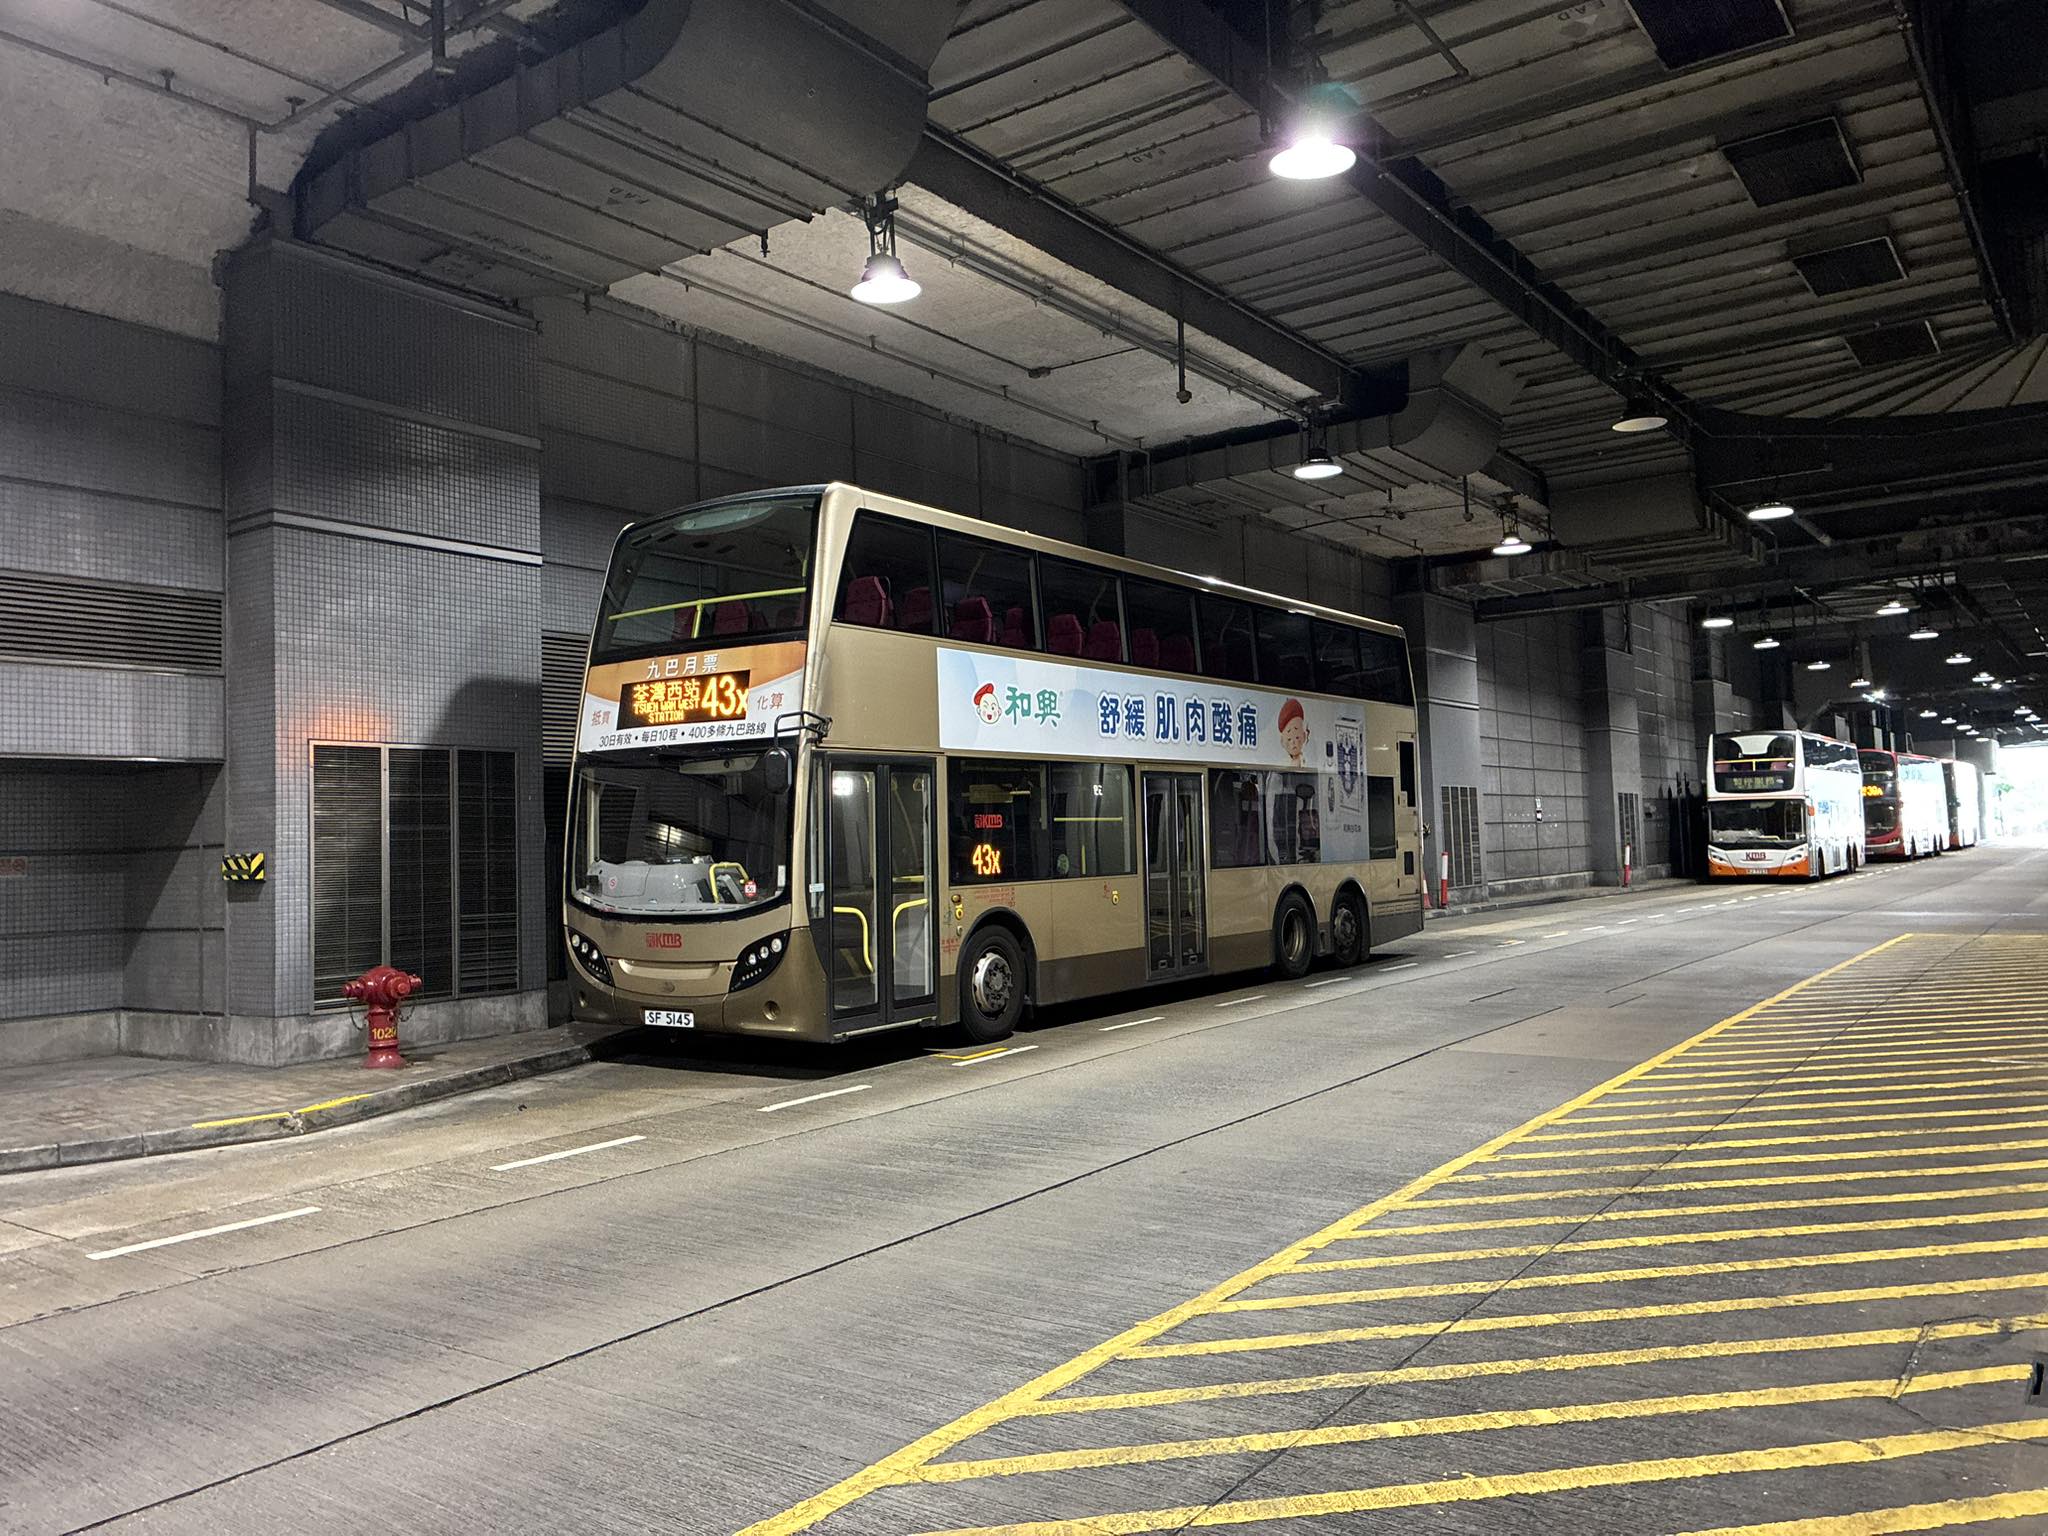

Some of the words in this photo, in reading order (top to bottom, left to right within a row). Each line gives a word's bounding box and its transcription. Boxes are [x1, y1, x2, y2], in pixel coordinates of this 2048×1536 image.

[646, 653, 718, 679] 九巴月票
[633, 679, 700, 703] 荃灣西站
[633, 701, 659, 714] TSUEN
[661, 699, 677, 712] WAN
[678, 698, 700, 710] WEST
[757, 692, 784, 711] 化算
[1004, 686, 1061, 728] 和興
[648, 710, 685, 723] STATION
[1099, 691, 1258, 747] 舒緩肌肉酸痛
[1745, 851, 1767, 861] KMB
[656, 932, 682, 949] KMB
[648, 1011, 662, 1024] SF
[665, 1012, 691, 1026] 5145
